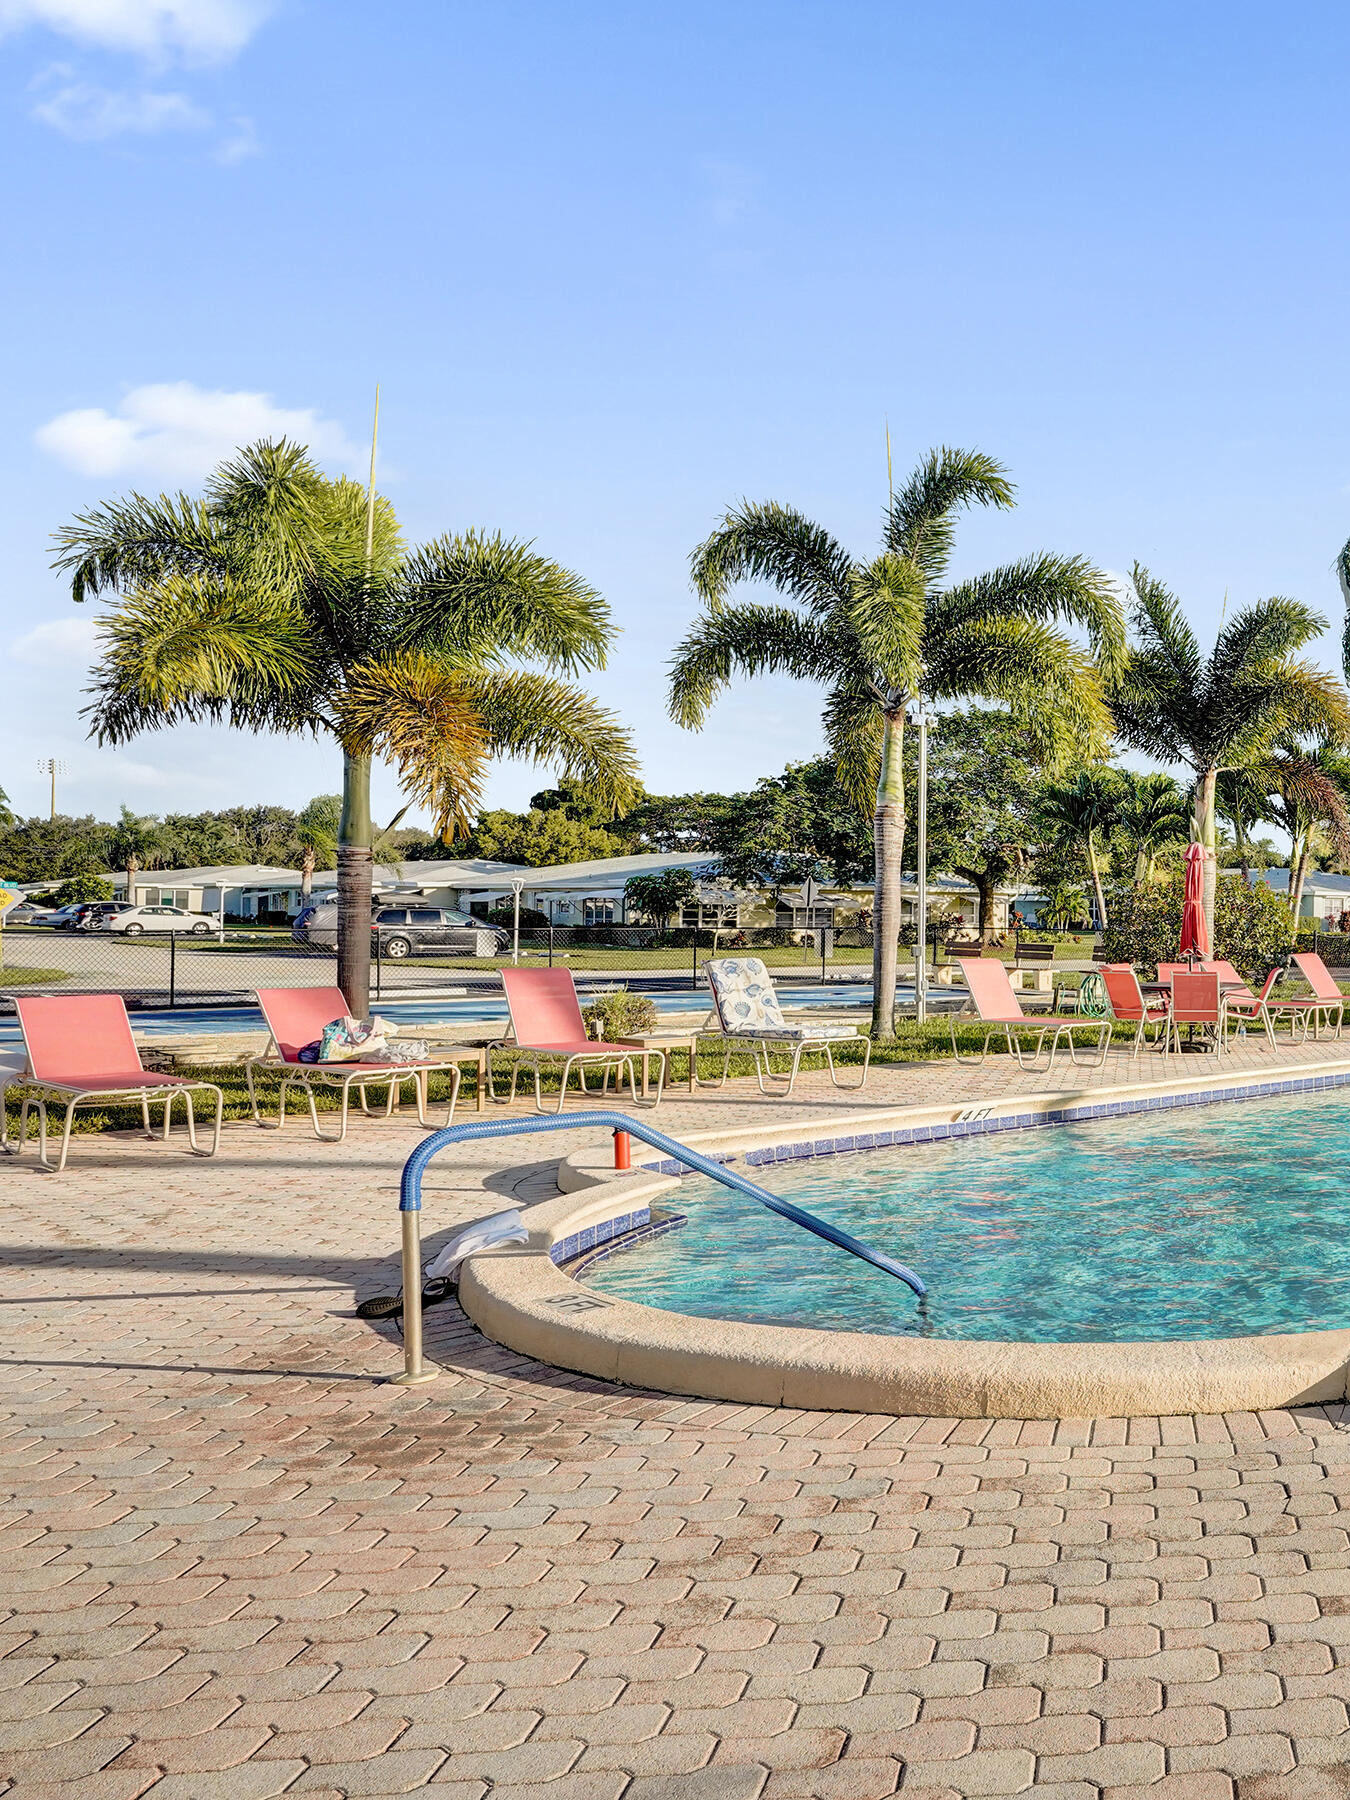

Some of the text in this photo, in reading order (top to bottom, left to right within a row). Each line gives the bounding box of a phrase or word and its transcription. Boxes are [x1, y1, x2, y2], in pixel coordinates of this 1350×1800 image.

[961, 1107, 996, 1122] 4 FT
[544, 1295, 606, 1313] 3 FT
